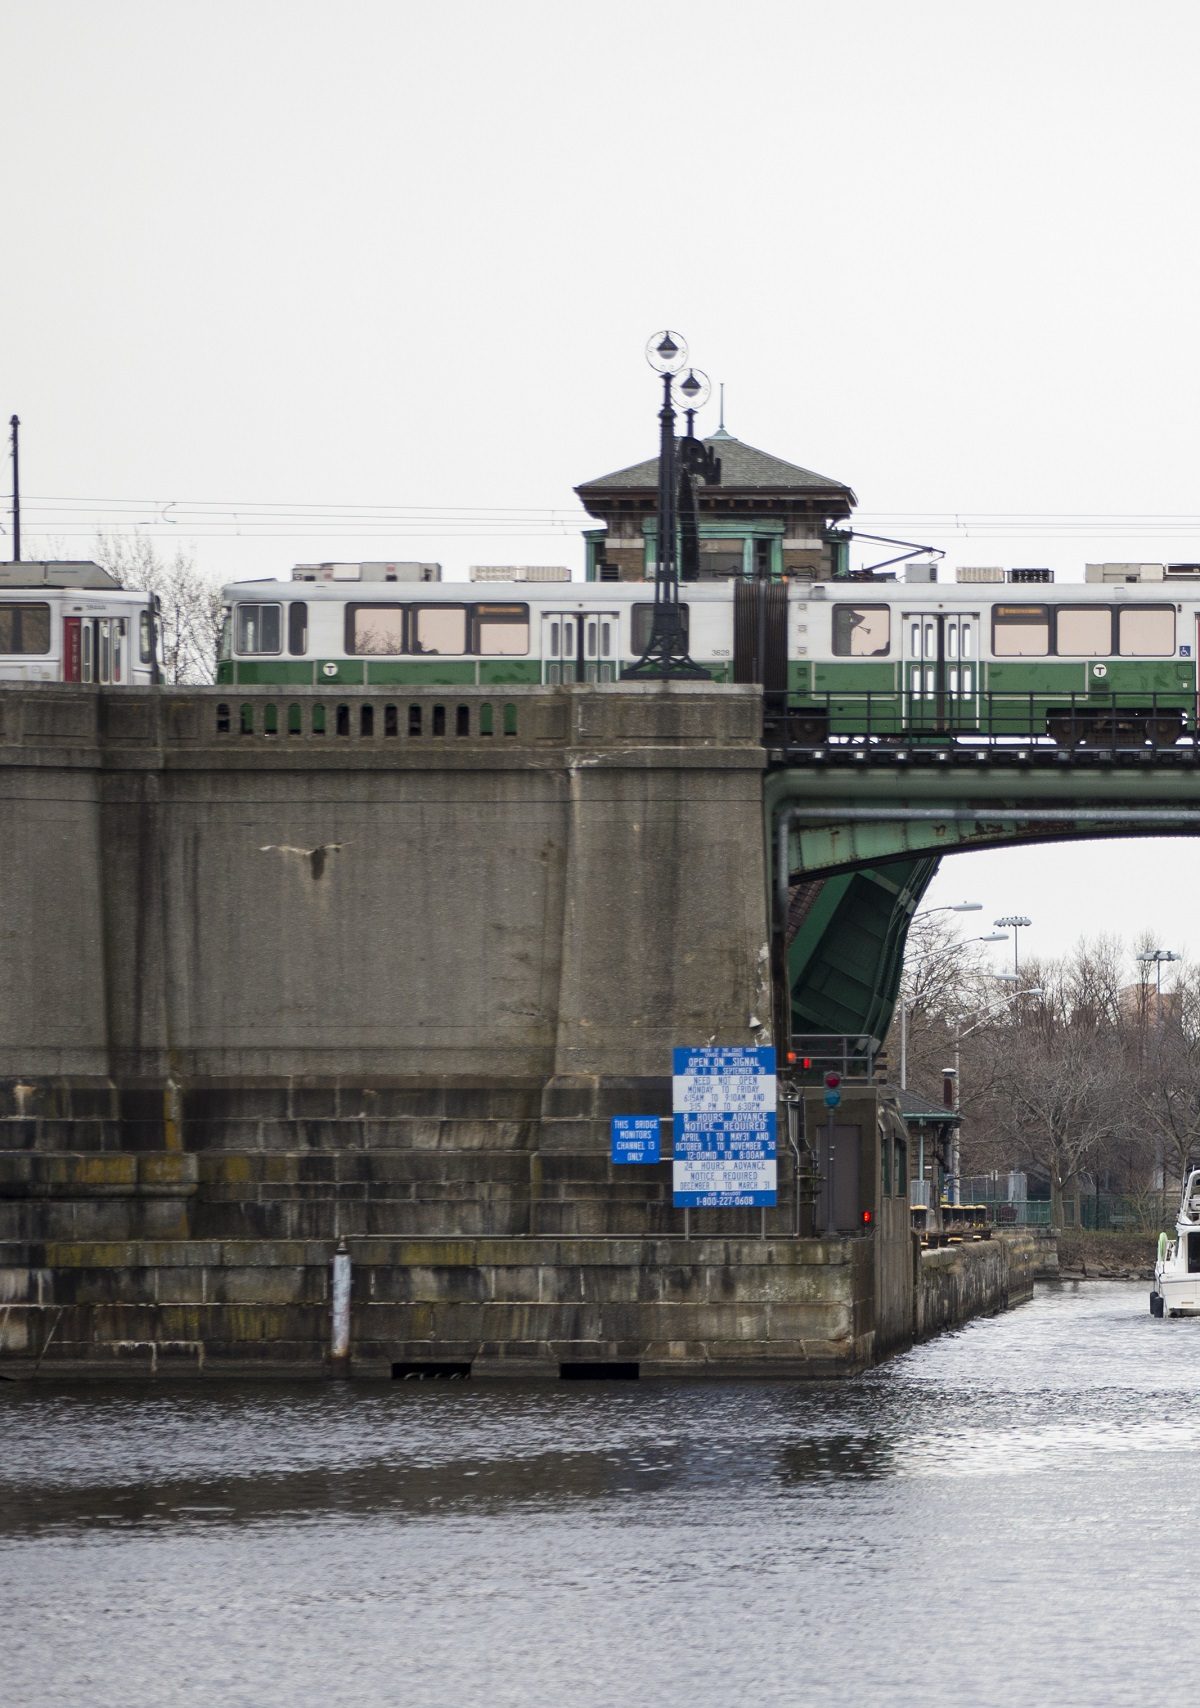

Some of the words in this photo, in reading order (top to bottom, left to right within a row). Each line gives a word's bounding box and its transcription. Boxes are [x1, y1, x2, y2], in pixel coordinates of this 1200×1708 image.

[1095, 667, 1104, 676] T
[688, 1058, 708, 1066] OPEN
[714, 1058, 724, 1066] ON
[733, 1058, 759, 1066] SIGNAL
[685, 1067, 697, 1075] JUNE
[711, 1067, 718, 1075] TO
[723, 1067, 752, 1075] SEPTEMBER
[694, 1077, 710, 1085] NEED
[719, 1077, 730, 1085] NOT
[739, 1077, 757, 1085] OPEN
[711, 1094, 718, 1102] TO
[753, 1094, 764, 1102] AND
[708, 1103, 716, 1111] PM
[723, 1103, 730, 1111] TO
[684, 1113, 688, 1121] 8
[697, 1113, 723, 1121] HOURS
[732, 1113, 767, 1121] ADVANCE
[614, 1120, 628, 1129] THIS
[635, 1120, 658, 1129] BRIDGE
[685, 1122, 713, 1131] NOTICE
[724, 1122, 766, 1131] REQUIRED
[620, 1131, 651, 1139] MONITORS
[681, 1133, 700, 1141] APRIL
[716, 1133, 723, 1141] TO
[756, 1133, 768, 1141] AND
[617, 1142, 645, 1150] CHANNEL
[648, 1142, 655, 1150] 13
[676, 1142, 702, 1150] OCTOBER
[717, 1142, 724, 1150] TO
[730, 1142, 761, 1150] NOVEMBER
[767, 1142, 775, 1150] 30
[627, 1152, 643, 1161] ONLY
[724, 1151, 732, 1160] TO
[685, 1162, 692, 1170] 24
[702, 1162, 724, 1170] HOURS
[734, 1162, 765, 1170] ADVANCE
[691, 1172, 714, 1180] NOTICE
[723, 1172, 757, 1180] REQUIRED
[680, 1182, 709, 1190] DECEMBER
[725, 1182, 732, 1190] TO
[739, 1182, 758, 1190] MARCH
